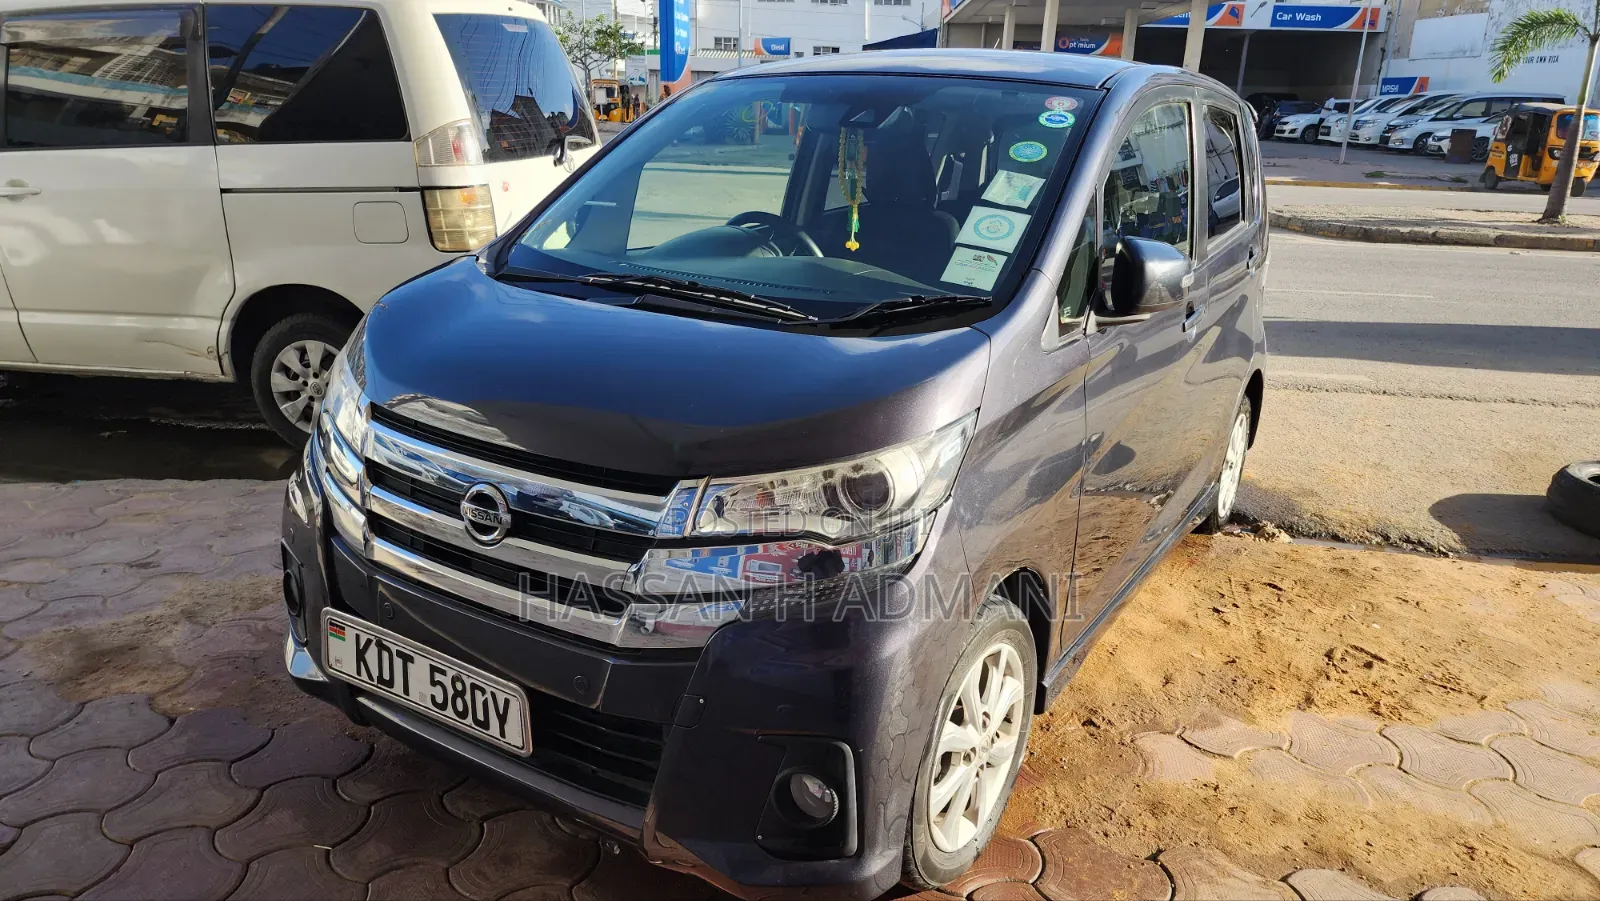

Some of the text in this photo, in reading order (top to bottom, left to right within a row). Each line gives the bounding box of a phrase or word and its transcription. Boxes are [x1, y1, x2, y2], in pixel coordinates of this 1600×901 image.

[1276, 12, 1322, 21] Car Wash
[463, 503, 503, 525] NISSAN
[354, 632, 511, 739] KDT 580Y
